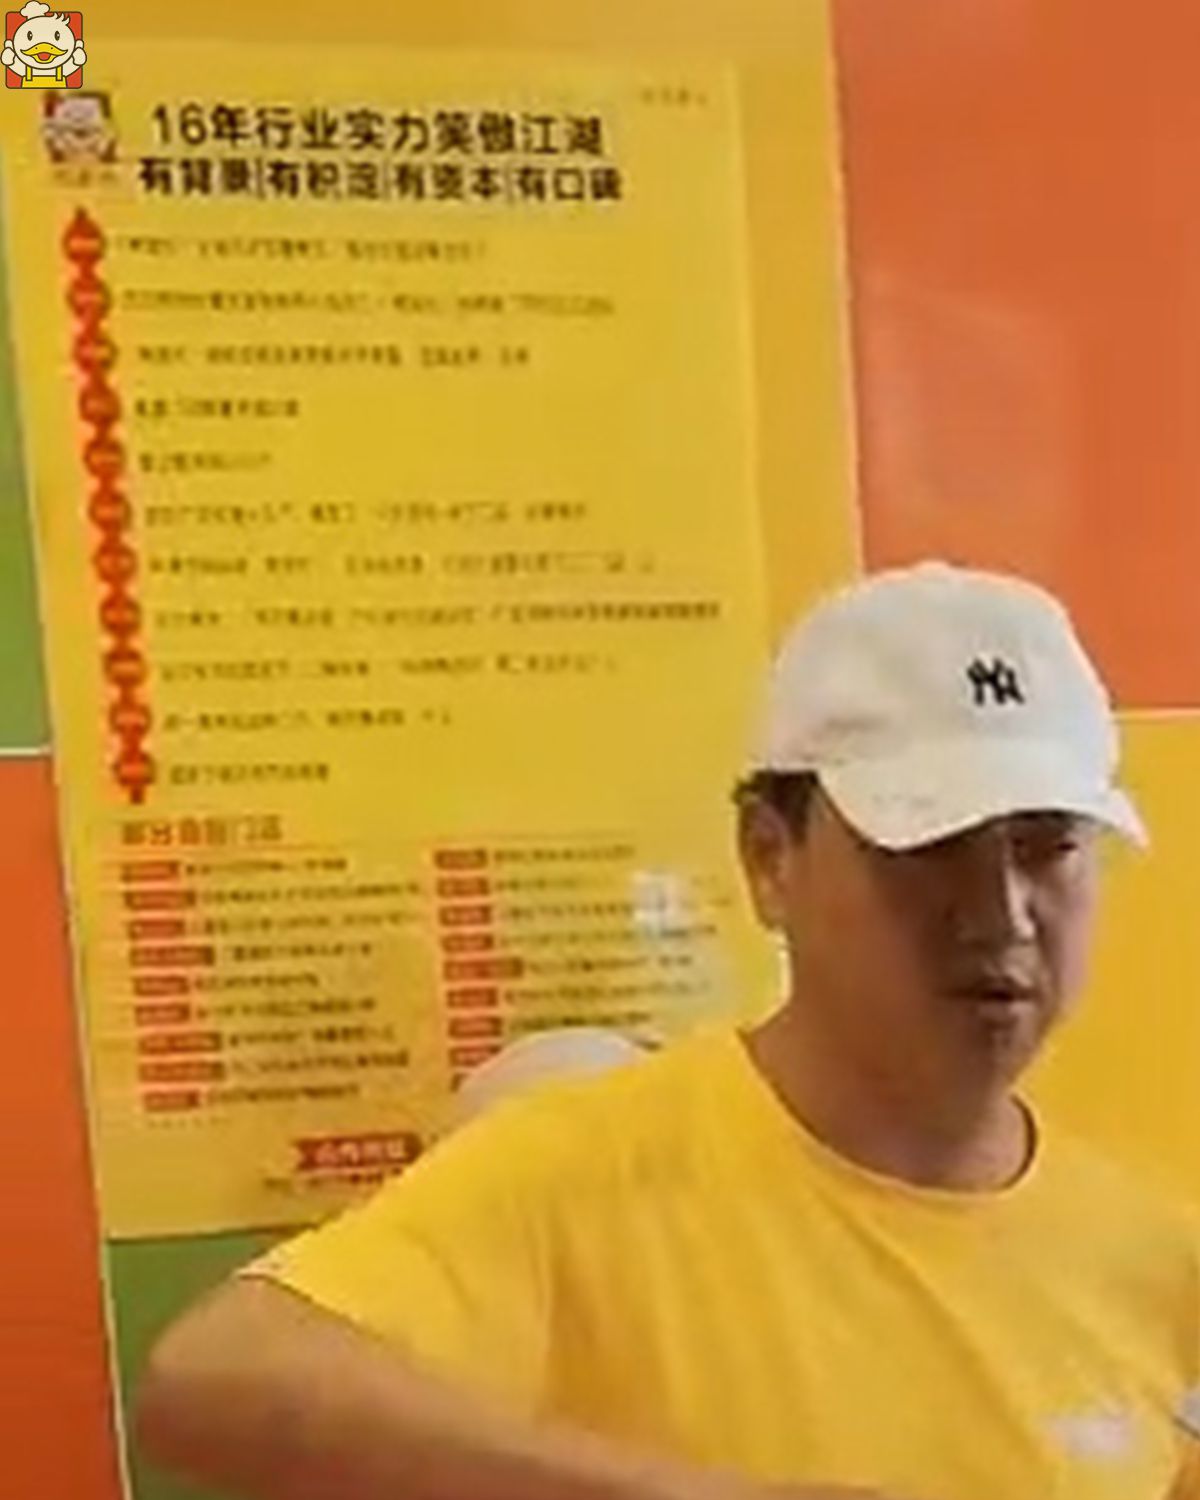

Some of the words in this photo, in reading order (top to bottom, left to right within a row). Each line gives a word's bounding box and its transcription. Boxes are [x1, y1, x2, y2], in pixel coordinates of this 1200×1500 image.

[150, 102, 603, 157] 16年行业实力笑傲江湖
